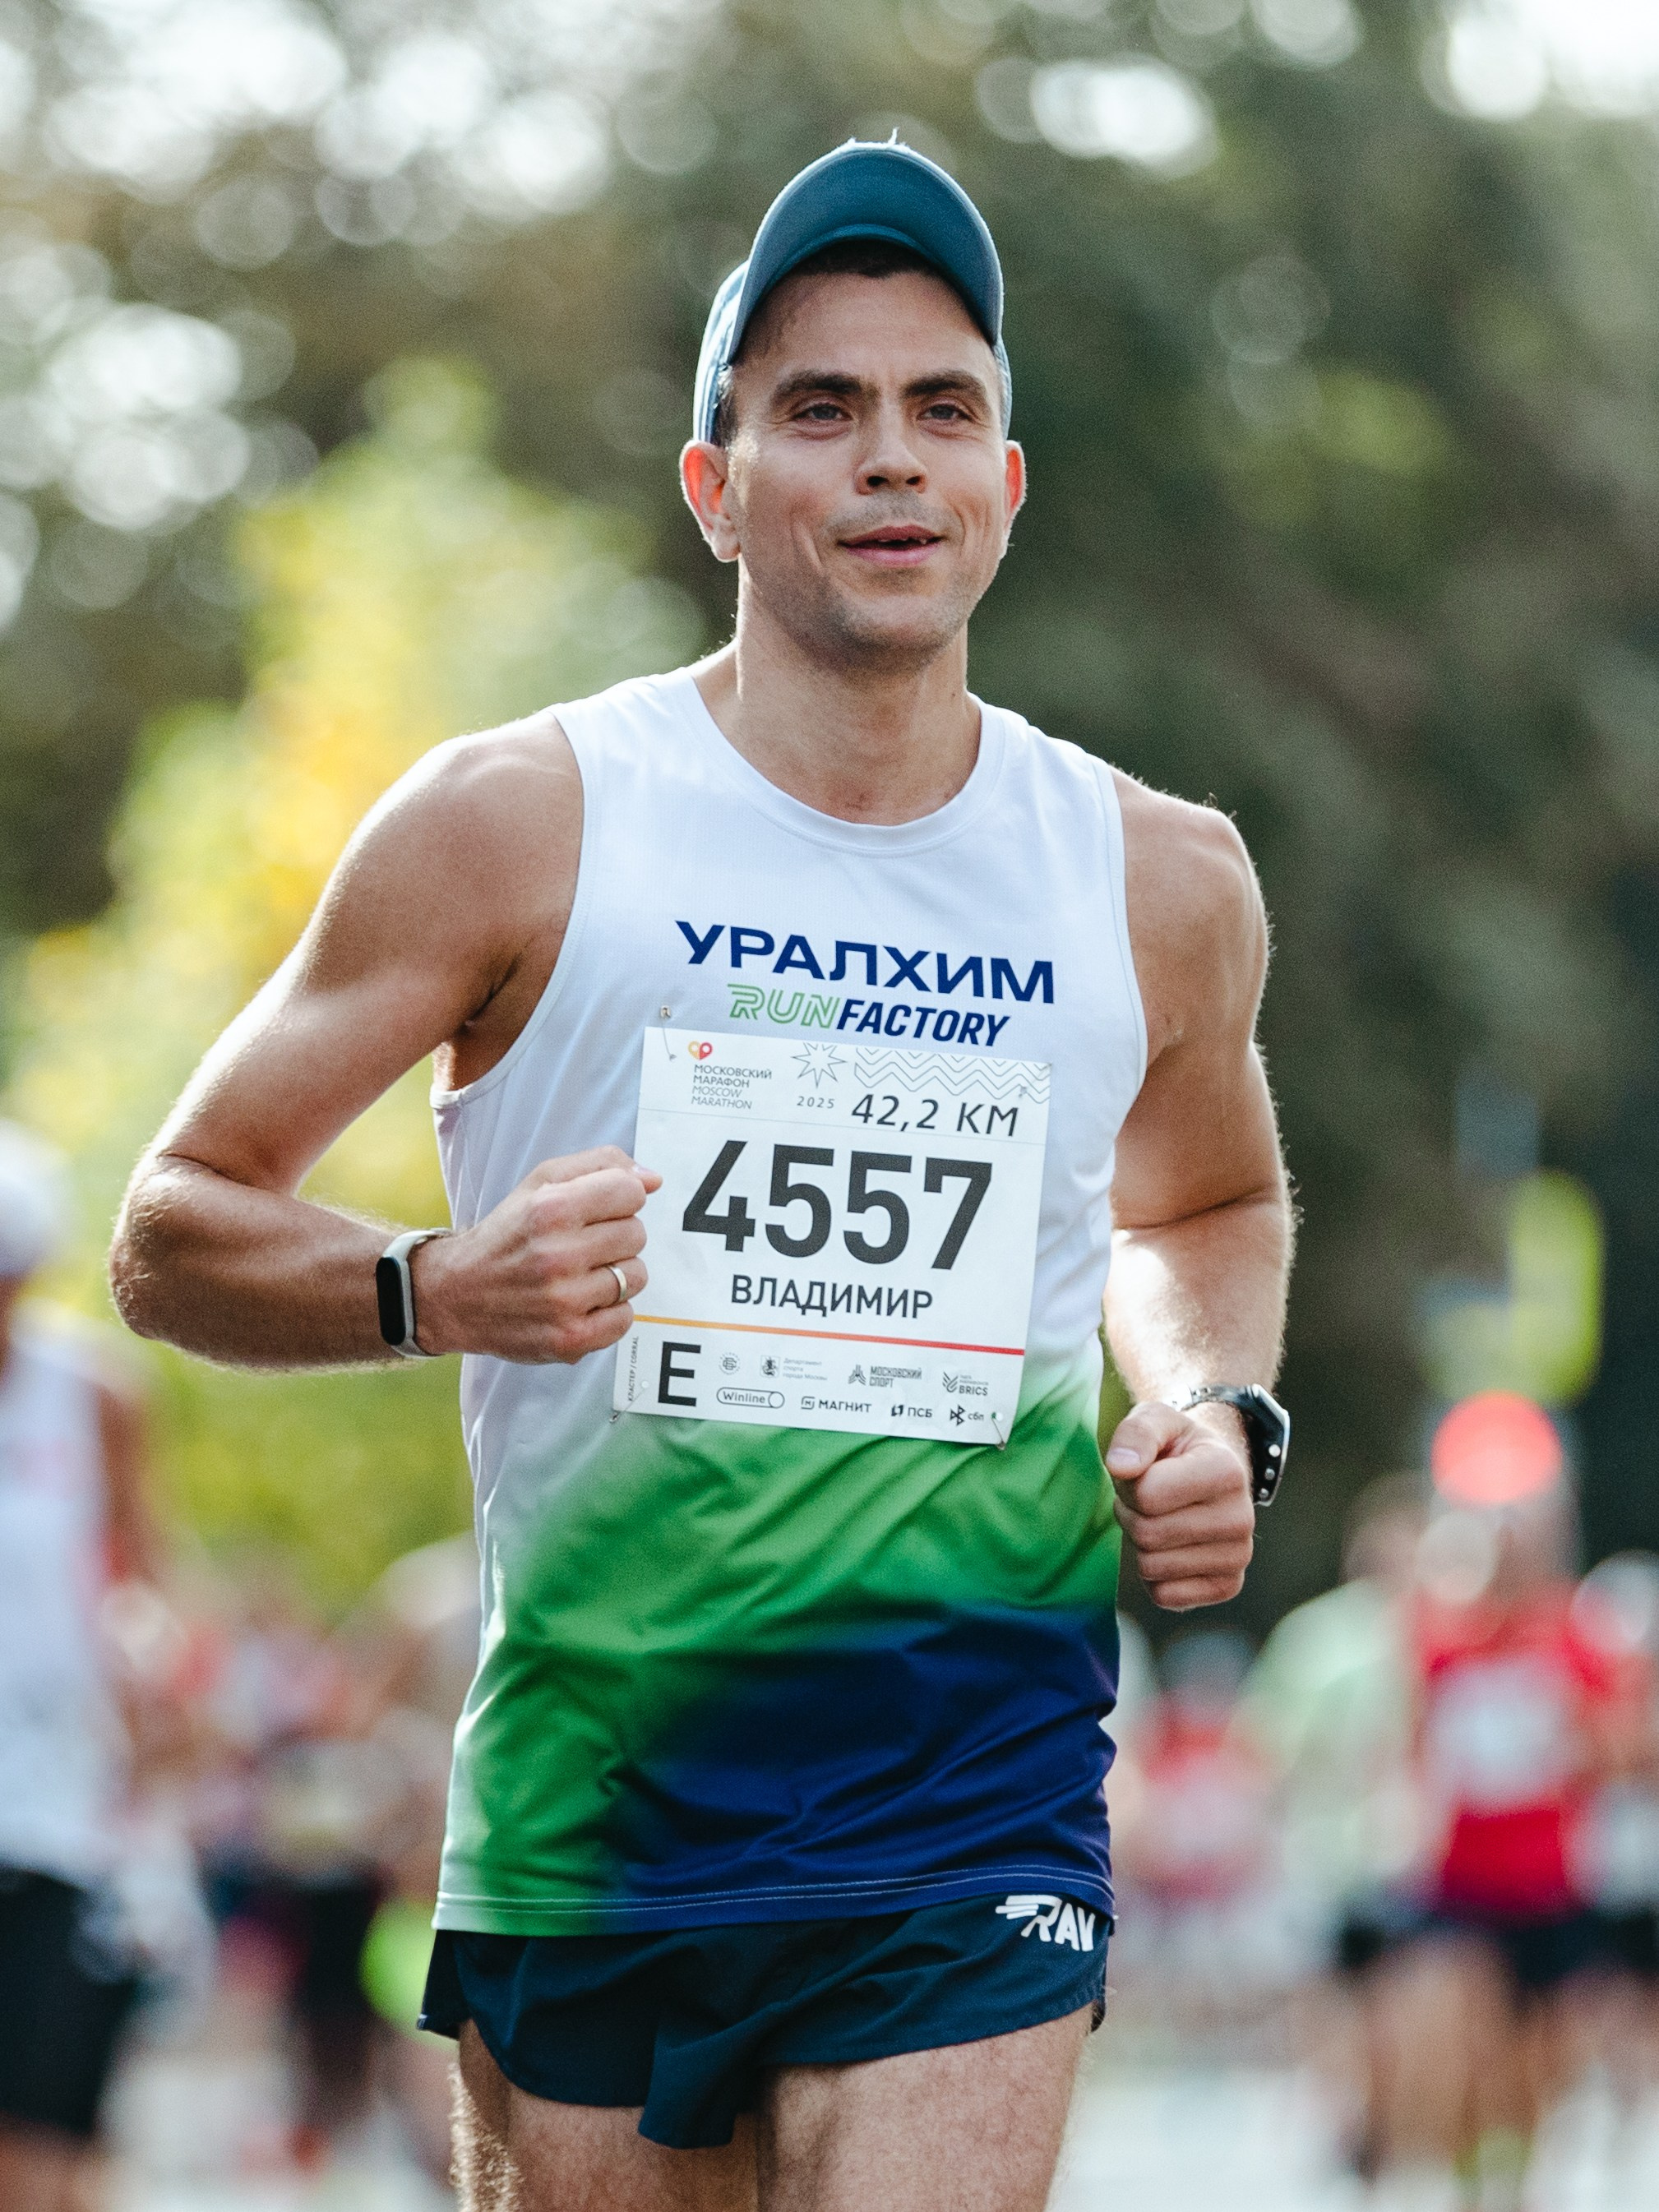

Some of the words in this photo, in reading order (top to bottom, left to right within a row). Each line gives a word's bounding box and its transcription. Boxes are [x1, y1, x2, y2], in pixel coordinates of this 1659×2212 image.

[675, 920, 1055, 1004] УРАЛХИМ
[694, 1064, 772, 1079] МОСКОВСКИЙ
[693, 1074, 750, 1088] МАРАФОН
[691, 1085, 742, 1097] MOSCOW
[691, 1096, 752, 1109] MARATHON
[797, 1096, 835, 1109] 2025
[851, 1093, 939, 1132] 42,2
[682, 1139, 992, 1270] 4557
[731, 1274, 933, 1318] ВЛАДИМИР
[658, 1341, 701, 1406] E
[871, 1365, 922, 1380] МОСКОВСКИЙ
[869, 1376, 894, 1388] СПОРТ
[723, 1390, 765, 1404] Winline
[959, 1384, 988, 1396] BRICS
[818, 1399, 872, 1413] МАГНИТ
[908, 1406, 933, 1418] ПСБ
